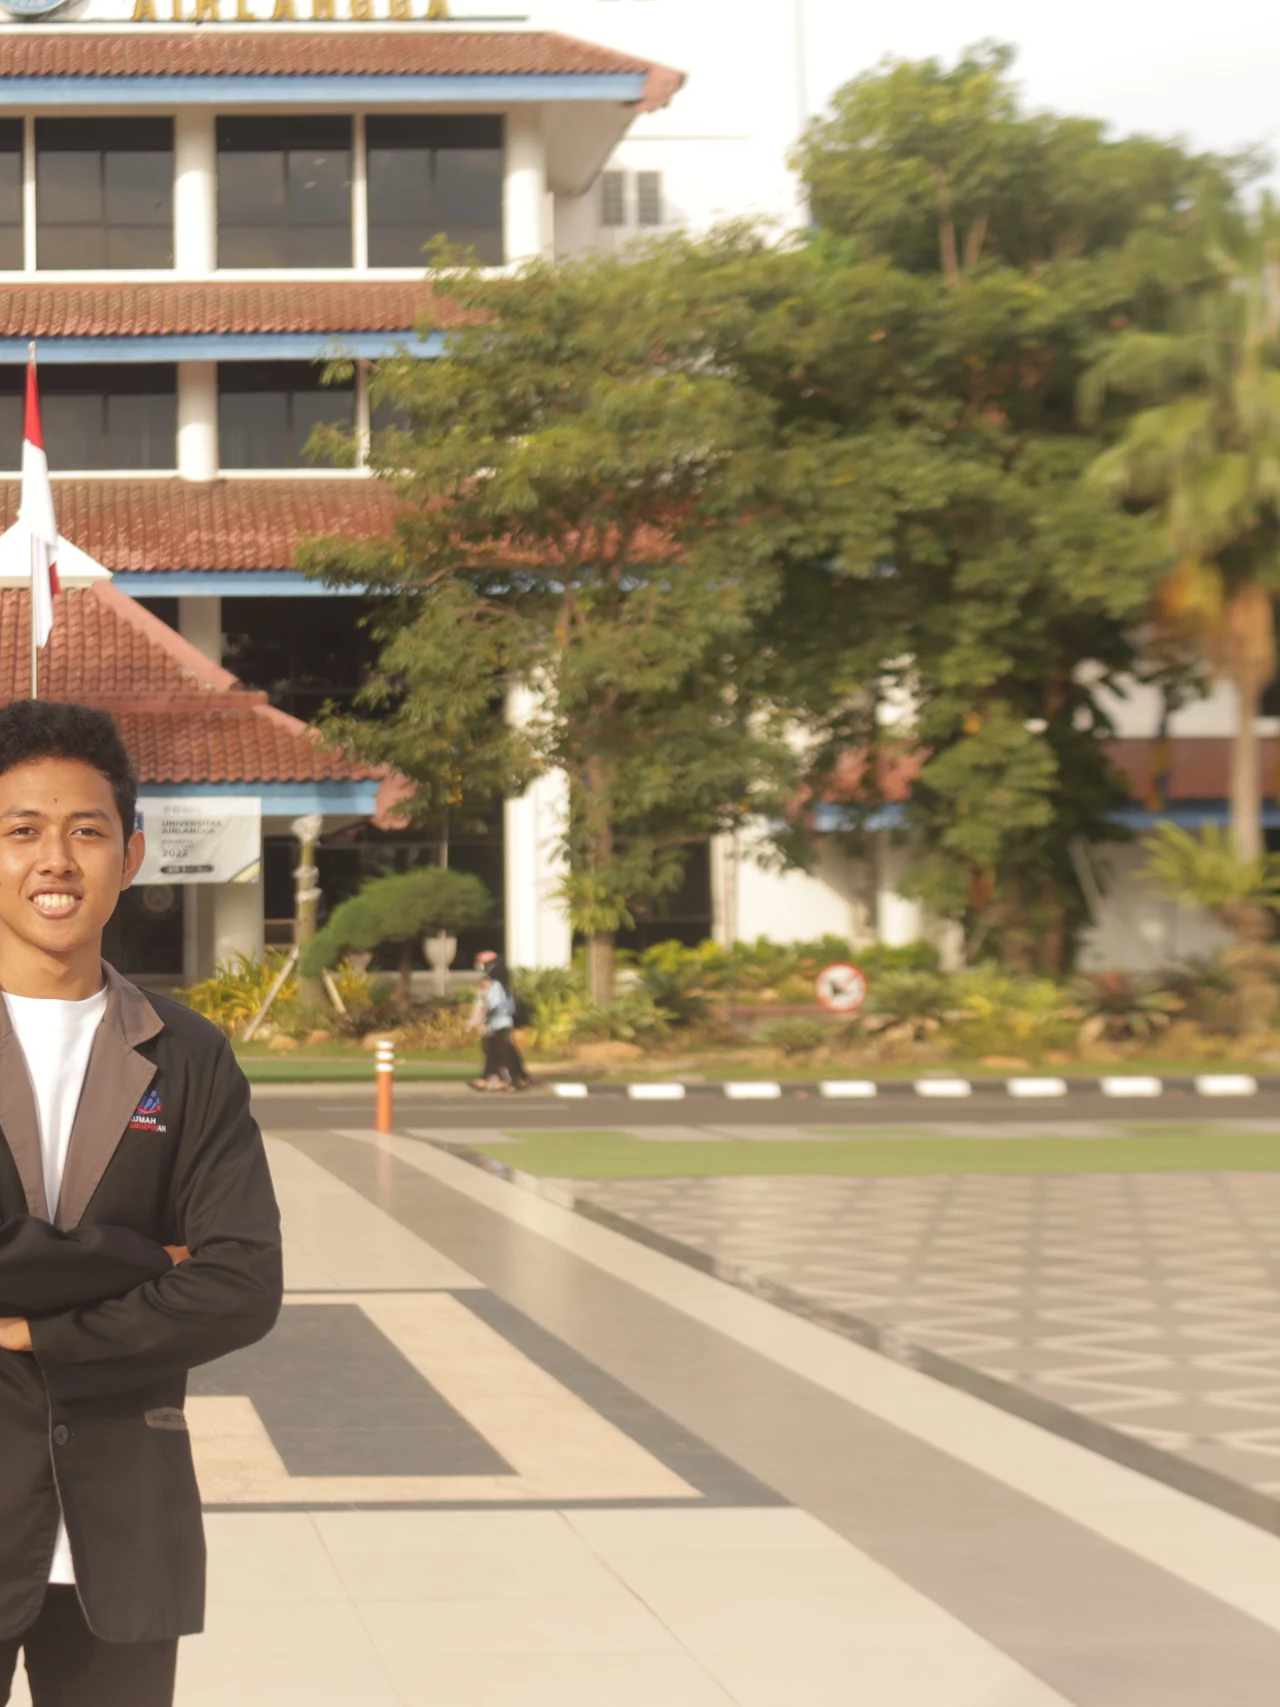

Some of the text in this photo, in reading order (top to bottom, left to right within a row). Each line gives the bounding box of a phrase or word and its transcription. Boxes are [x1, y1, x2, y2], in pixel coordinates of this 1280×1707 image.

[162, 819, 222, 827] UNIVERSITAS
[162, 848, 188, 858] 2022
[130, 1116, 156, 1124] UMAH
